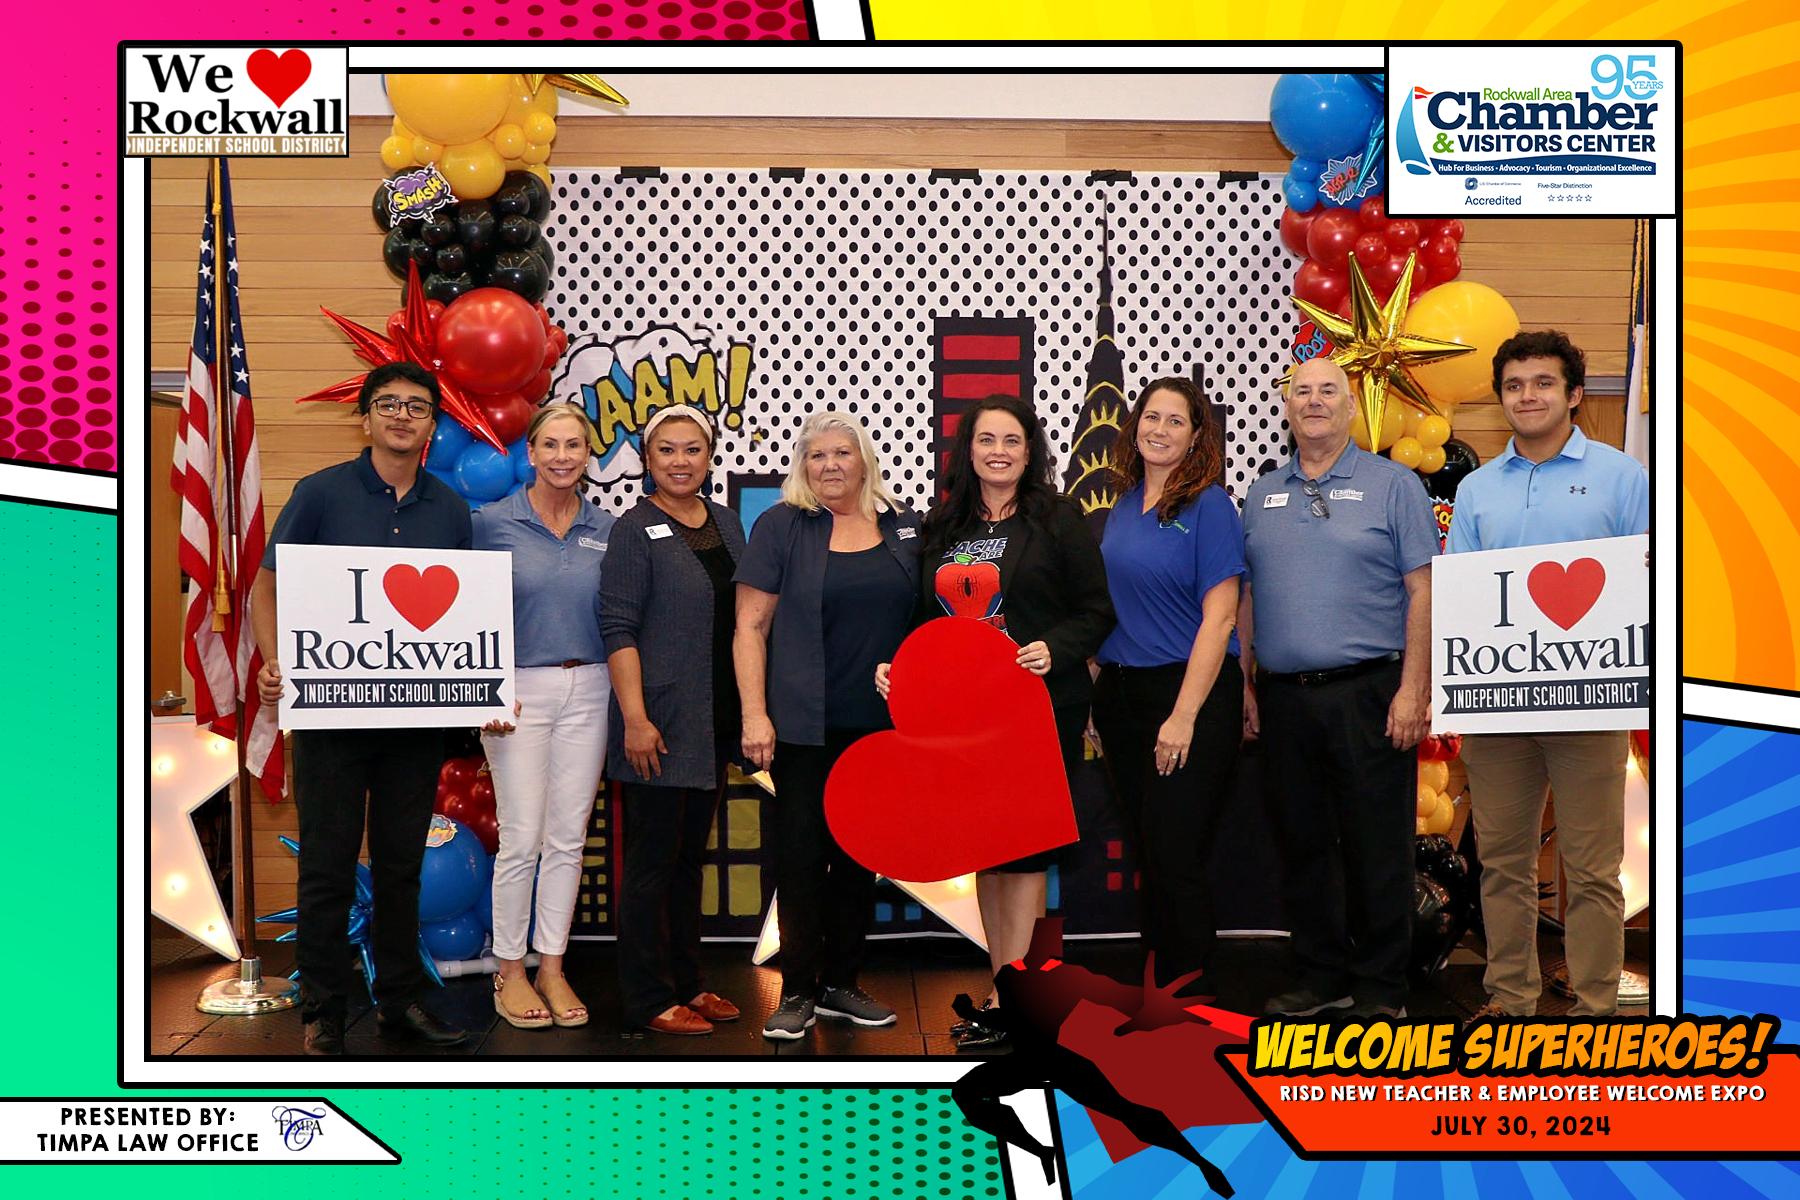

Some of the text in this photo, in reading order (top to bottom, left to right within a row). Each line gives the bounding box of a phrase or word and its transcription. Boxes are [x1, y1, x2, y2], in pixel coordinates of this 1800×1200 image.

[347, 568, 370, 624] I
[1494, 570, 1515, 628] I
[291, 628, 504, 671] Rockwall
[1442, 623, 1650, 677] Rockwall
[303, 682, 490, 704] INDEPENDENT SCHOOL DISTRICT
[1453, 682, 1640, 709] INDEPENDENT SCHOOL DISTRICT
